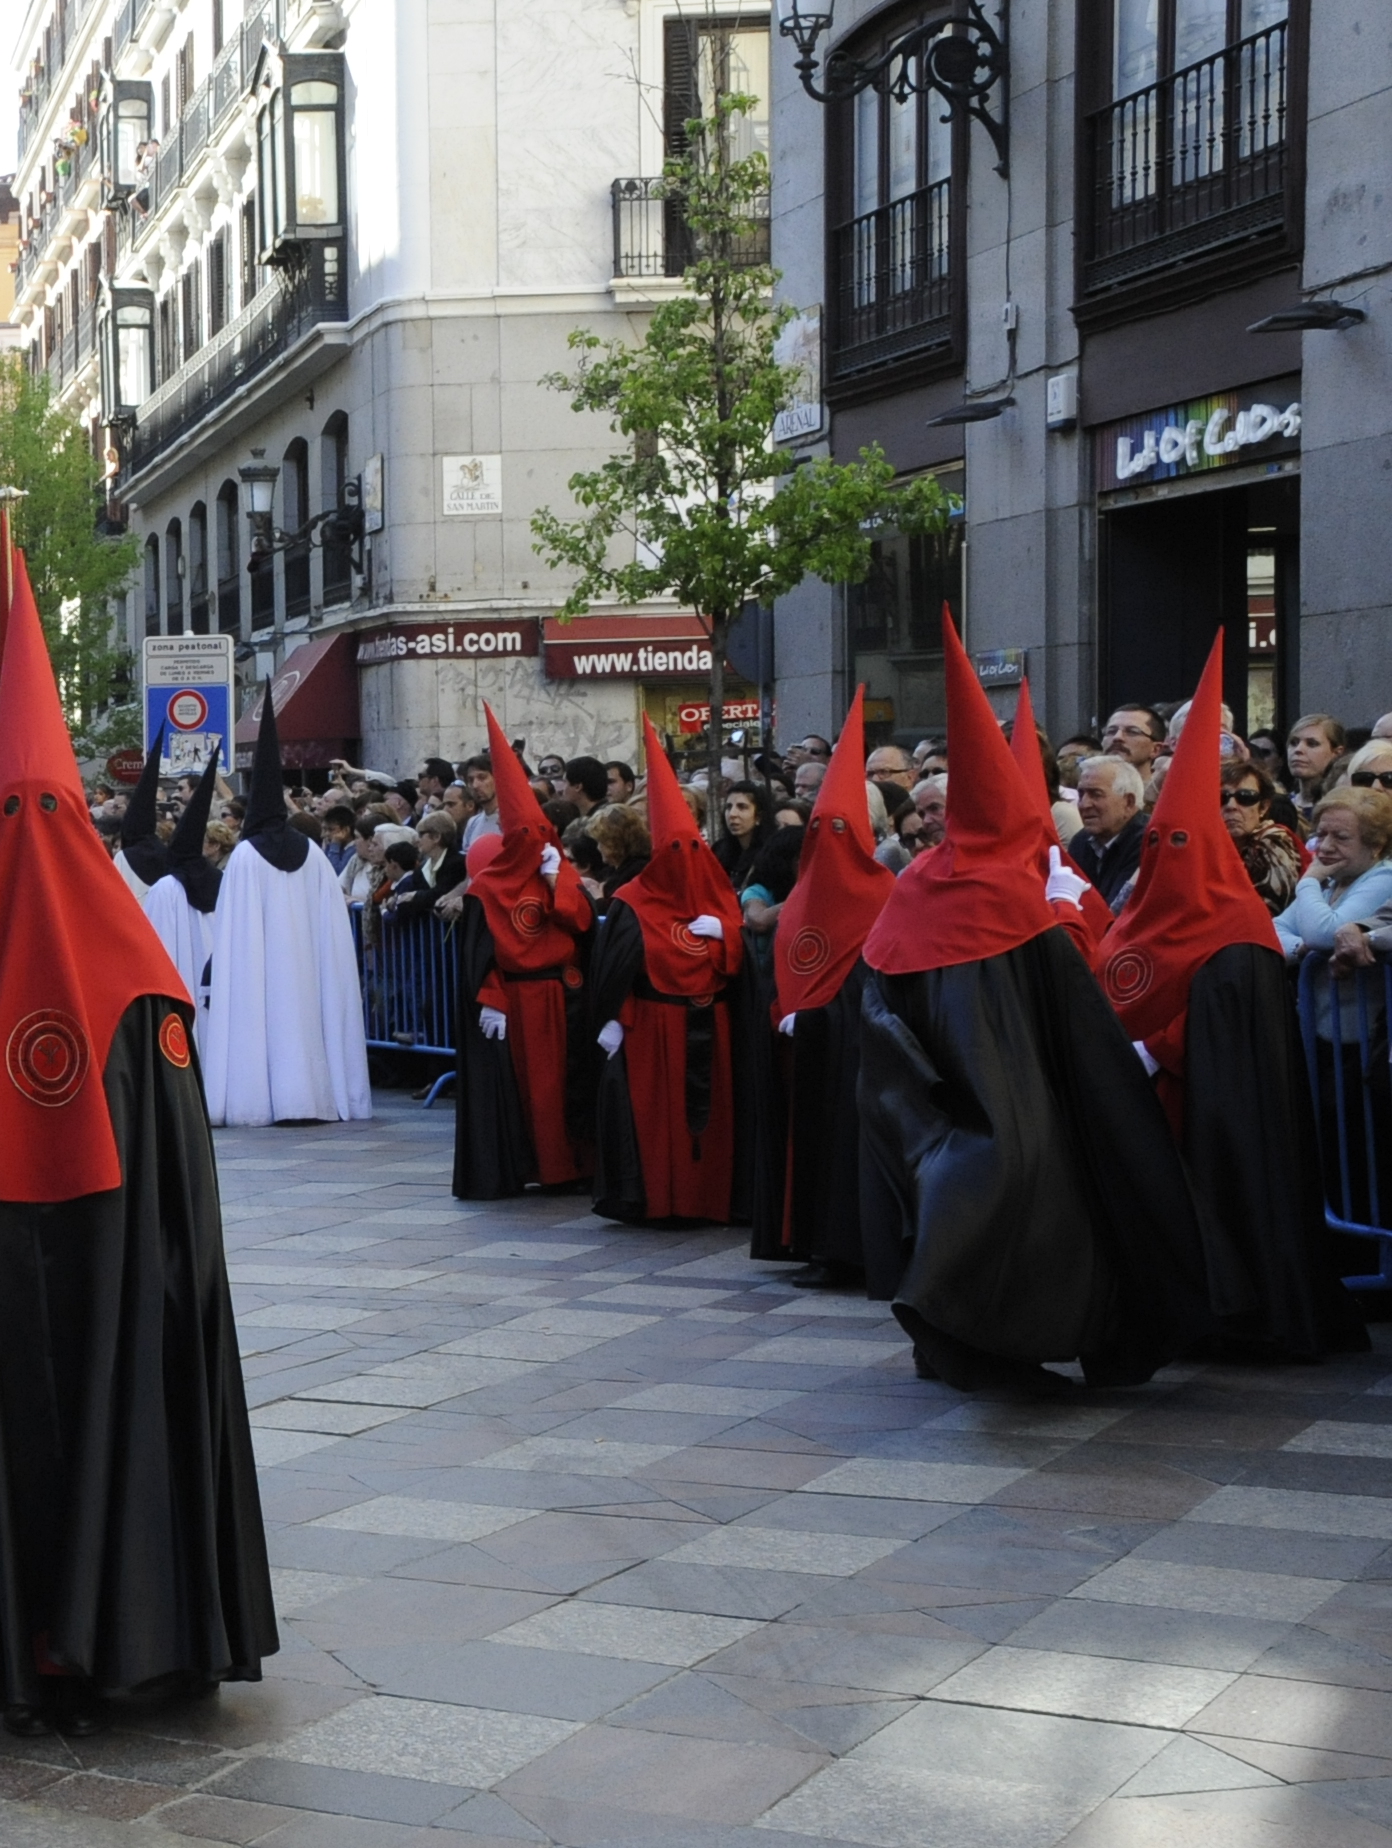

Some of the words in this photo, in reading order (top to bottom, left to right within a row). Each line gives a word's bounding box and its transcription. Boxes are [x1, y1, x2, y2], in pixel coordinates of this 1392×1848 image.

[777, 407, 817, 438] ARENAL
[450, 490, 476, 501] CALLE
[446, 502, 466, 512] SAN
[178, 641, 222, 651] peatonal
[573, 644, 726, 675] www.tienda
[680, 703, 777, 722] OFERT
[113, 758, 143, 770] Crem
